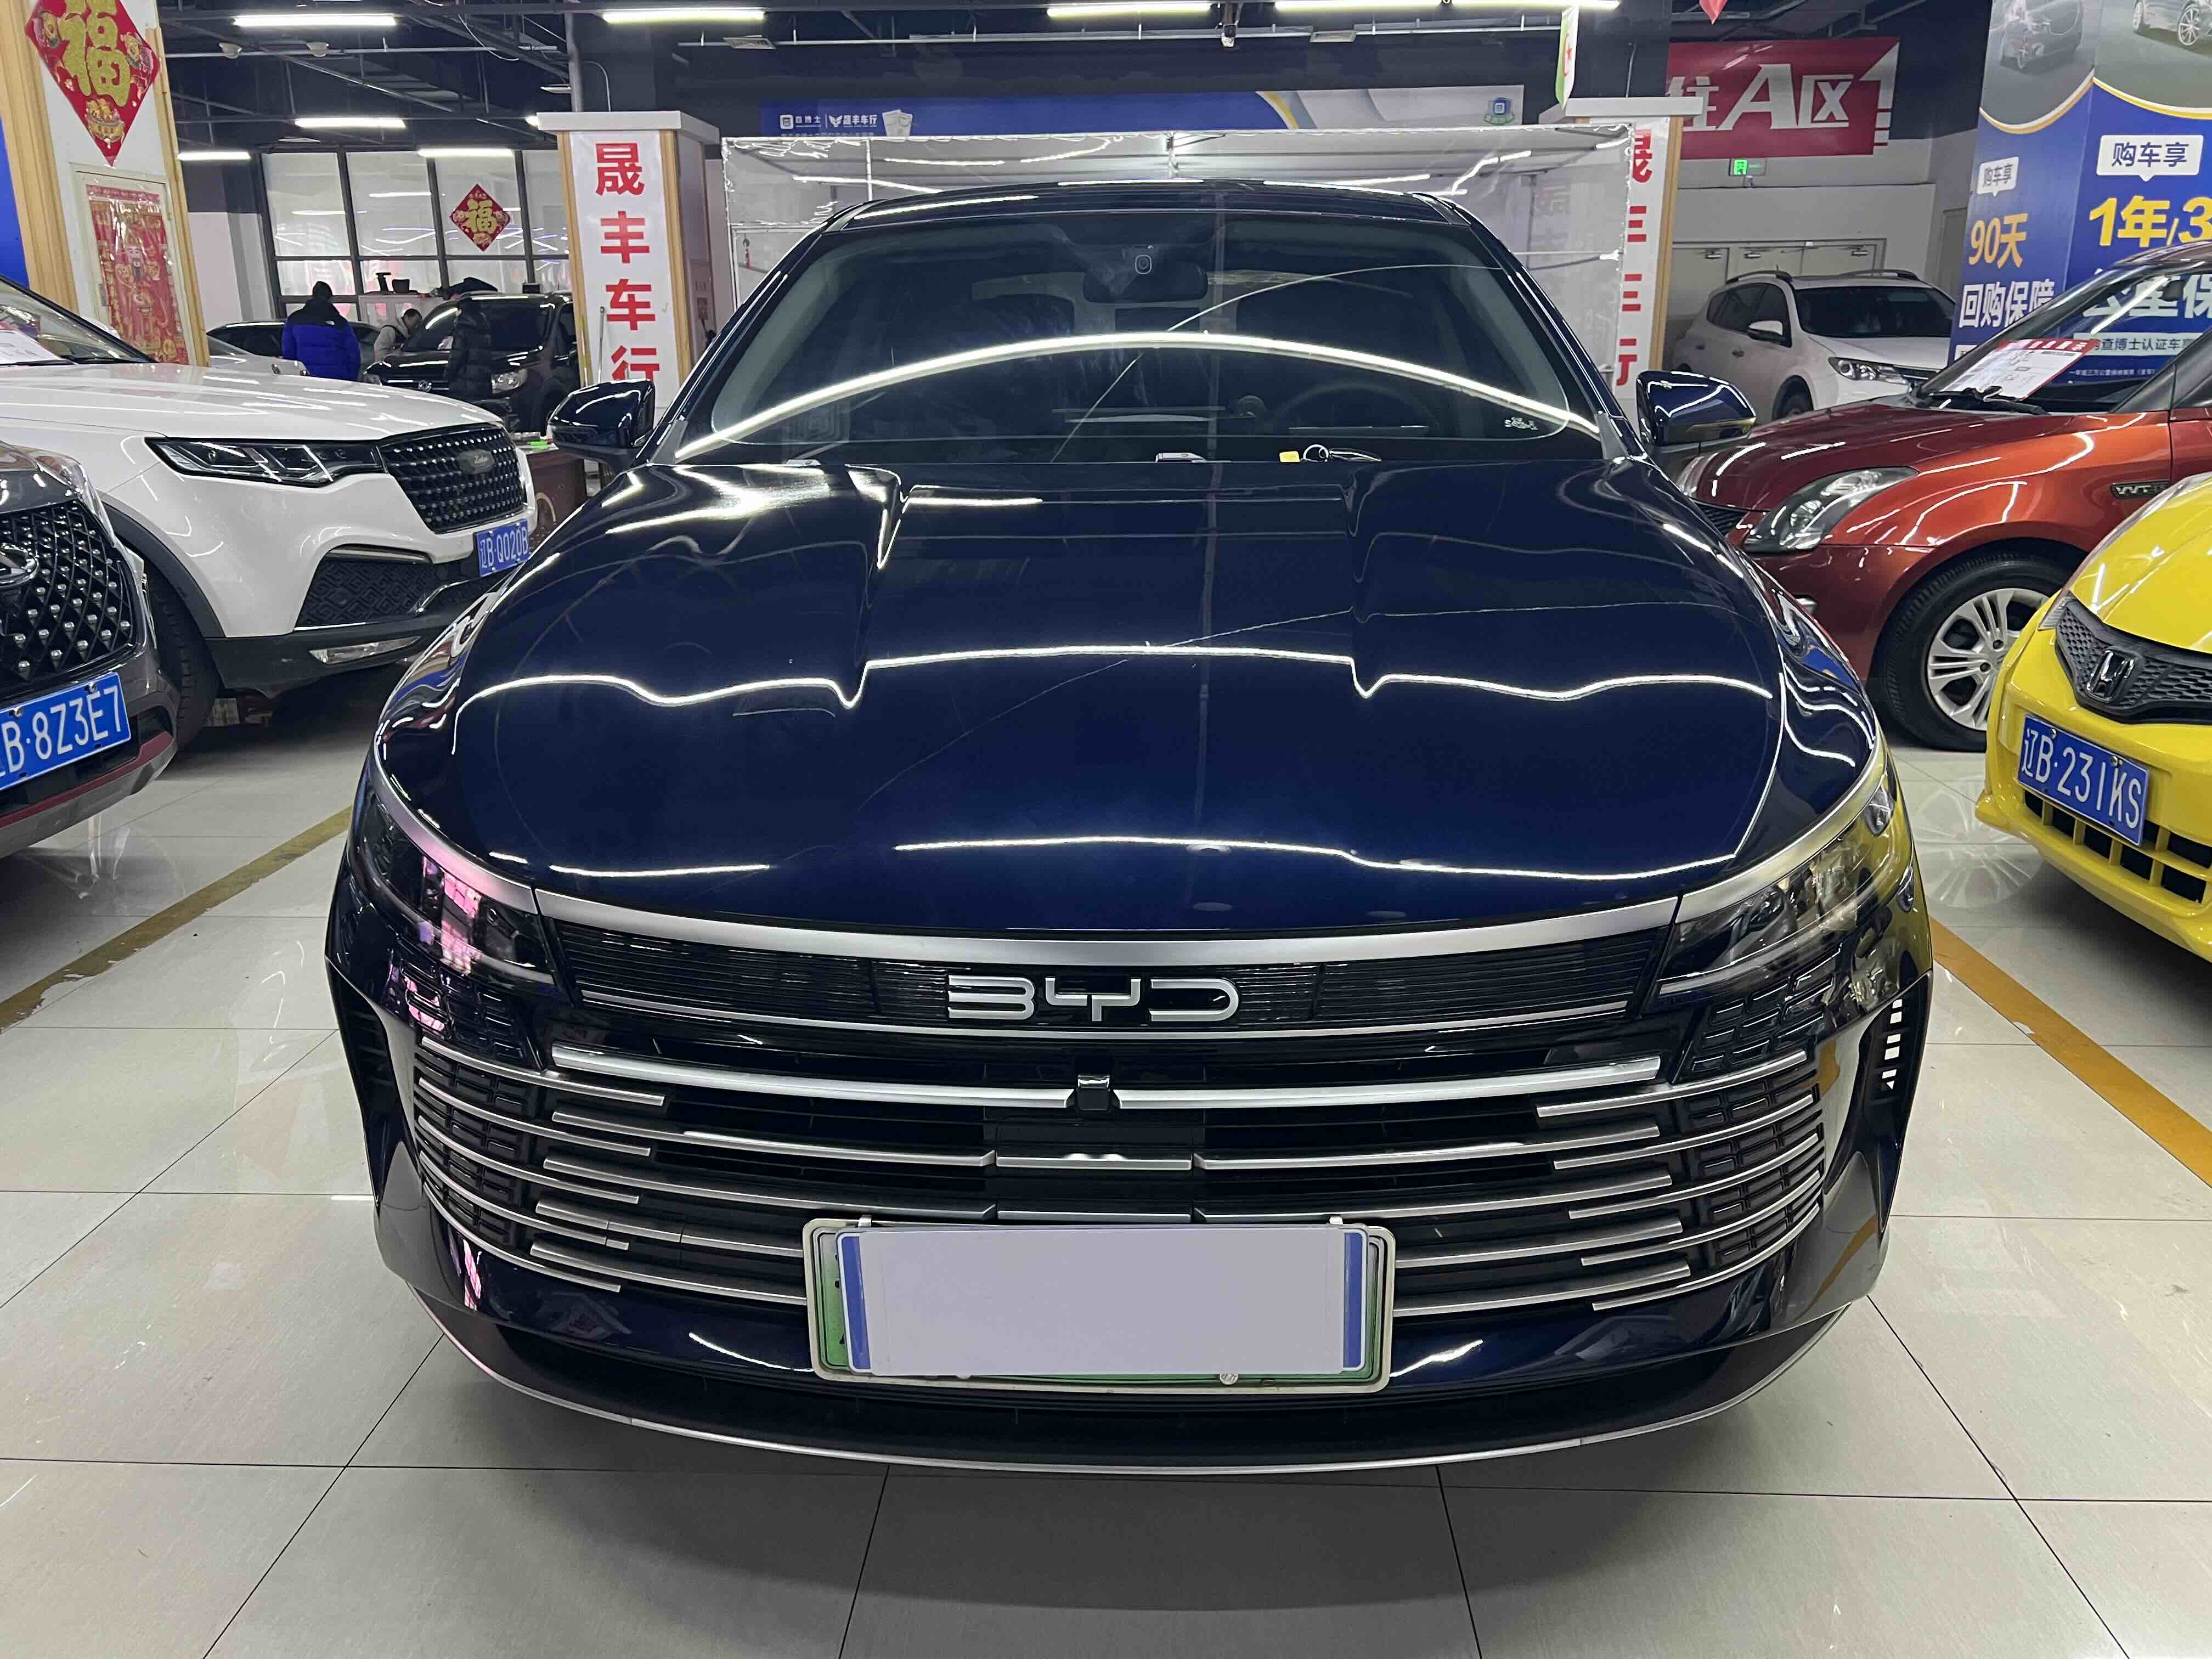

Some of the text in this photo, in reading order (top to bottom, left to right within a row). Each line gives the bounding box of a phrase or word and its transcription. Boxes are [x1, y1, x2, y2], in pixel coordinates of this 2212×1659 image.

[57, 0, 132, 107] 福
[1983, 164, 2013, 187] 购车享
[2111, 142, 2189, 167] 购车享
[595, 142, 659, 382] 晟丰车行
[1968, 213, 2028, 268] 90天
[2095, 337, 2194, 351] 查博士认证车
[0, 685, 121, 777] B·8Z3E7
[948, 974, 1239, 1022] BYD
